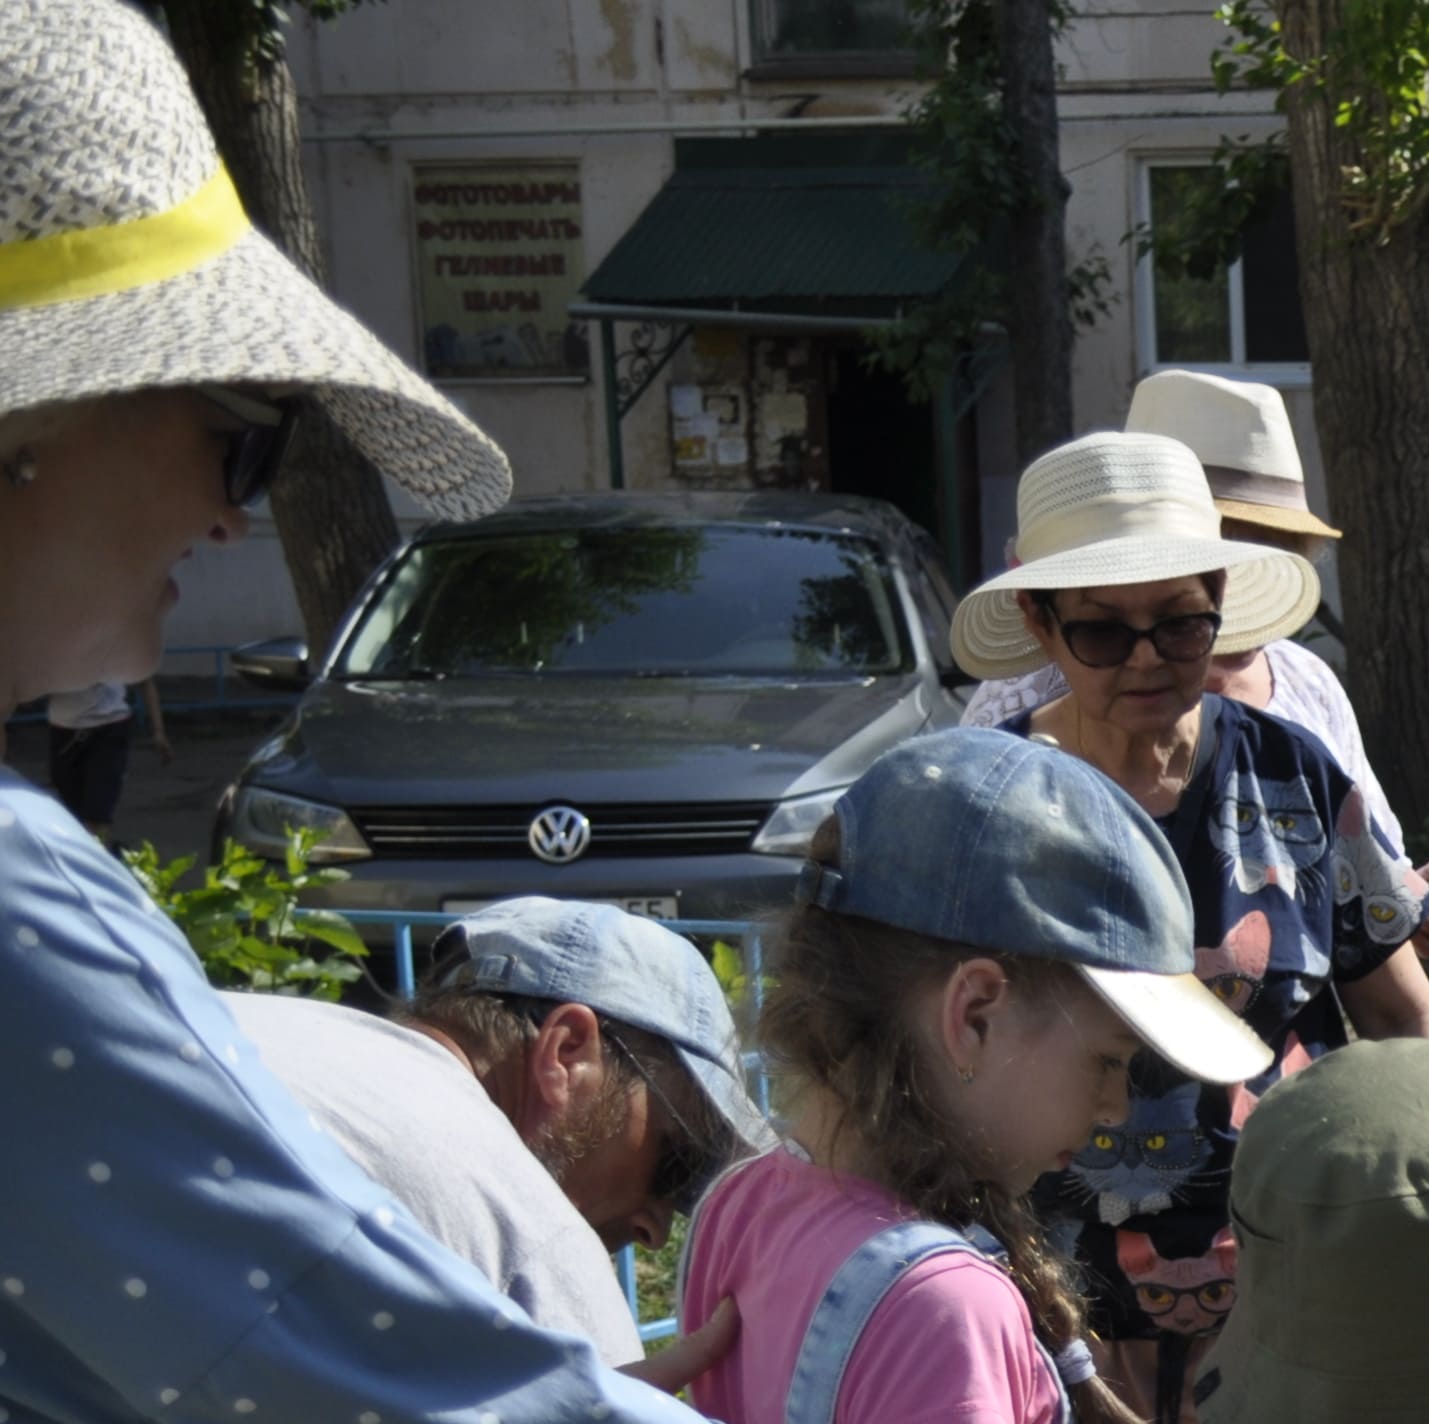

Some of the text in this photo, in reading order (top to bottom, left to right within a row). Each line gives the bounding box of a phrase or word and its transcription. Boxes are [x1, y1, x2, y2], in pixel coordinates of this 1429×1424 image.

[415, 181, 581, 205] ФОТОТОВАРЫ
[417, 219, 582, 241] ФОТОПЕЧАТЬ
[435, 254, 566, 277] ГЕЛИЕВЫЕ
[462, 290, 542, 312] ШАРЫ
